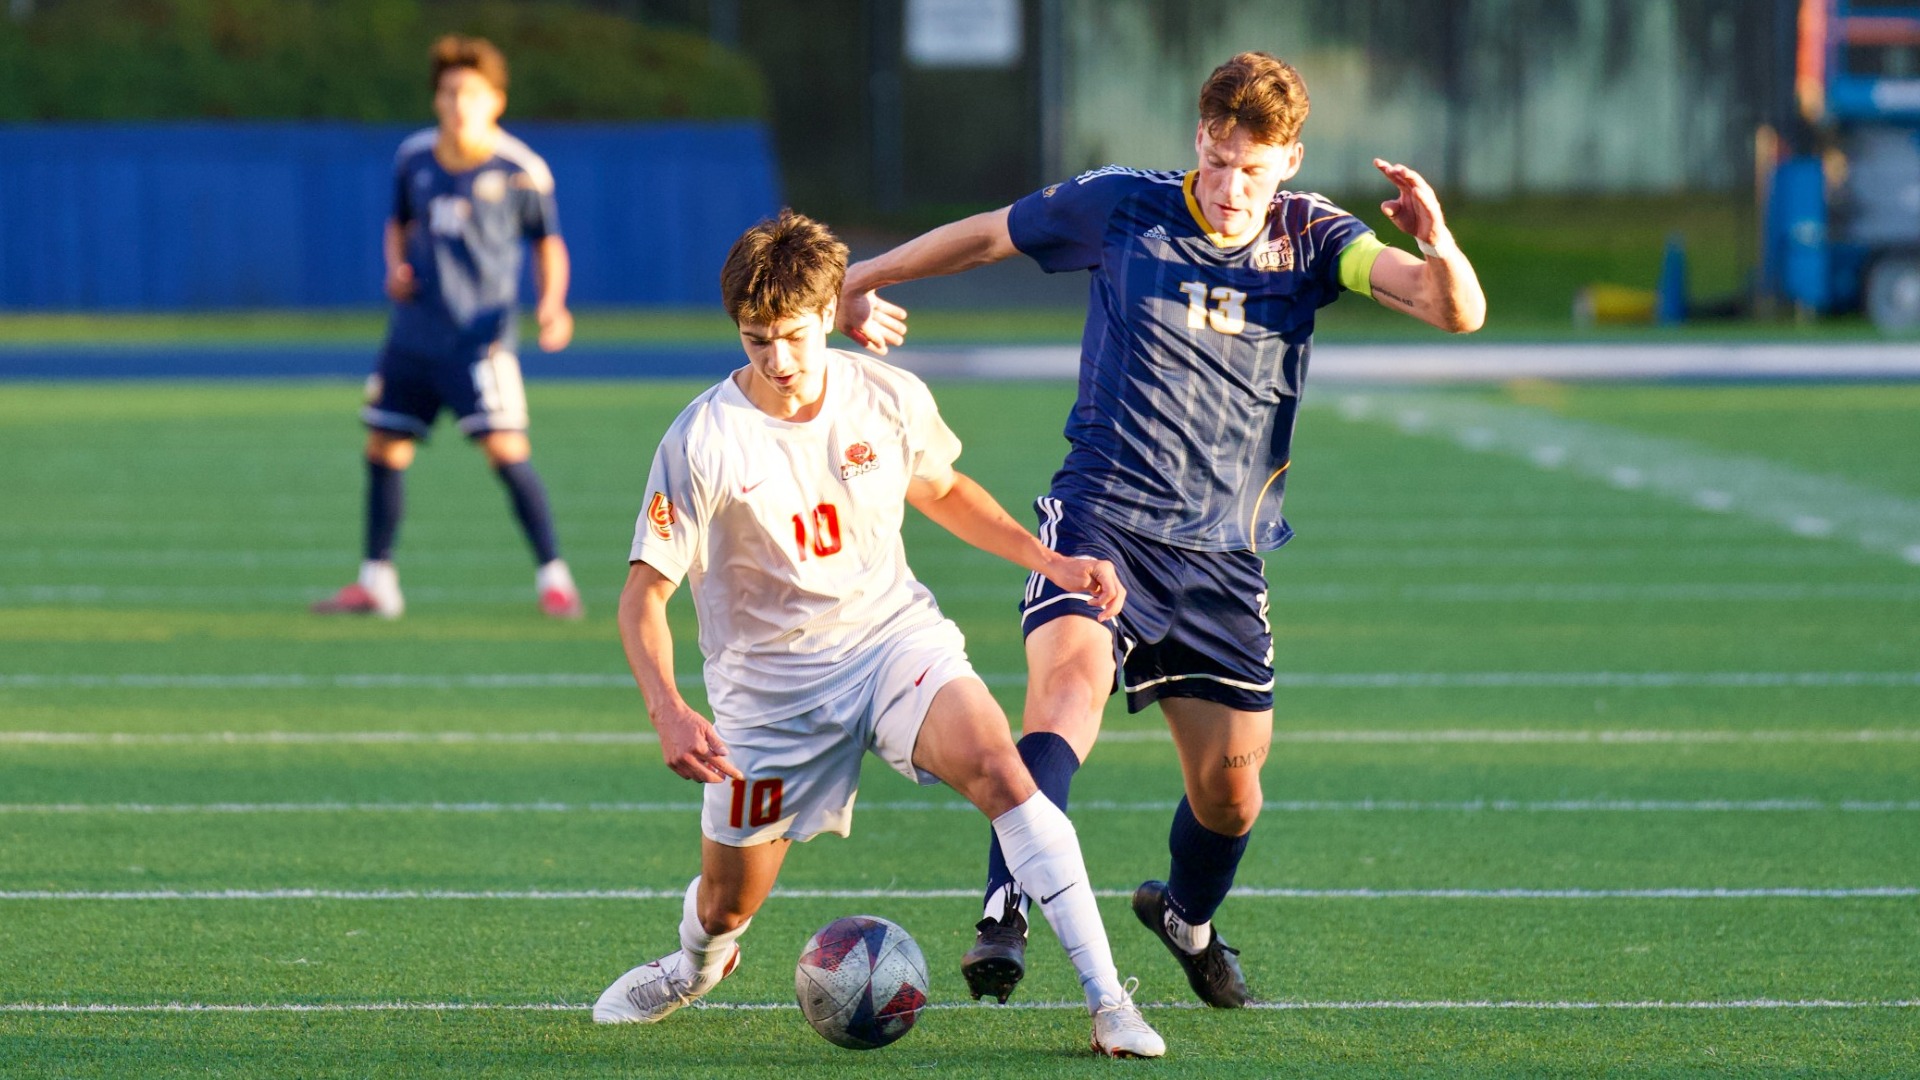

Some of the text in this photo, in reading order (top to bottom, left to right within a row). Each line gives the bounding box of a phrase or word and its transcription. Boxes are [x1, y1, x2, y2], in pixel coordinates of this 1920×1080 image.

[1143, 231, 1171, 242] adidas
[1179, 281, 1247, 335] 13
[792, 502, 842, 562] 10
[729, 777, 784, 829] 10
